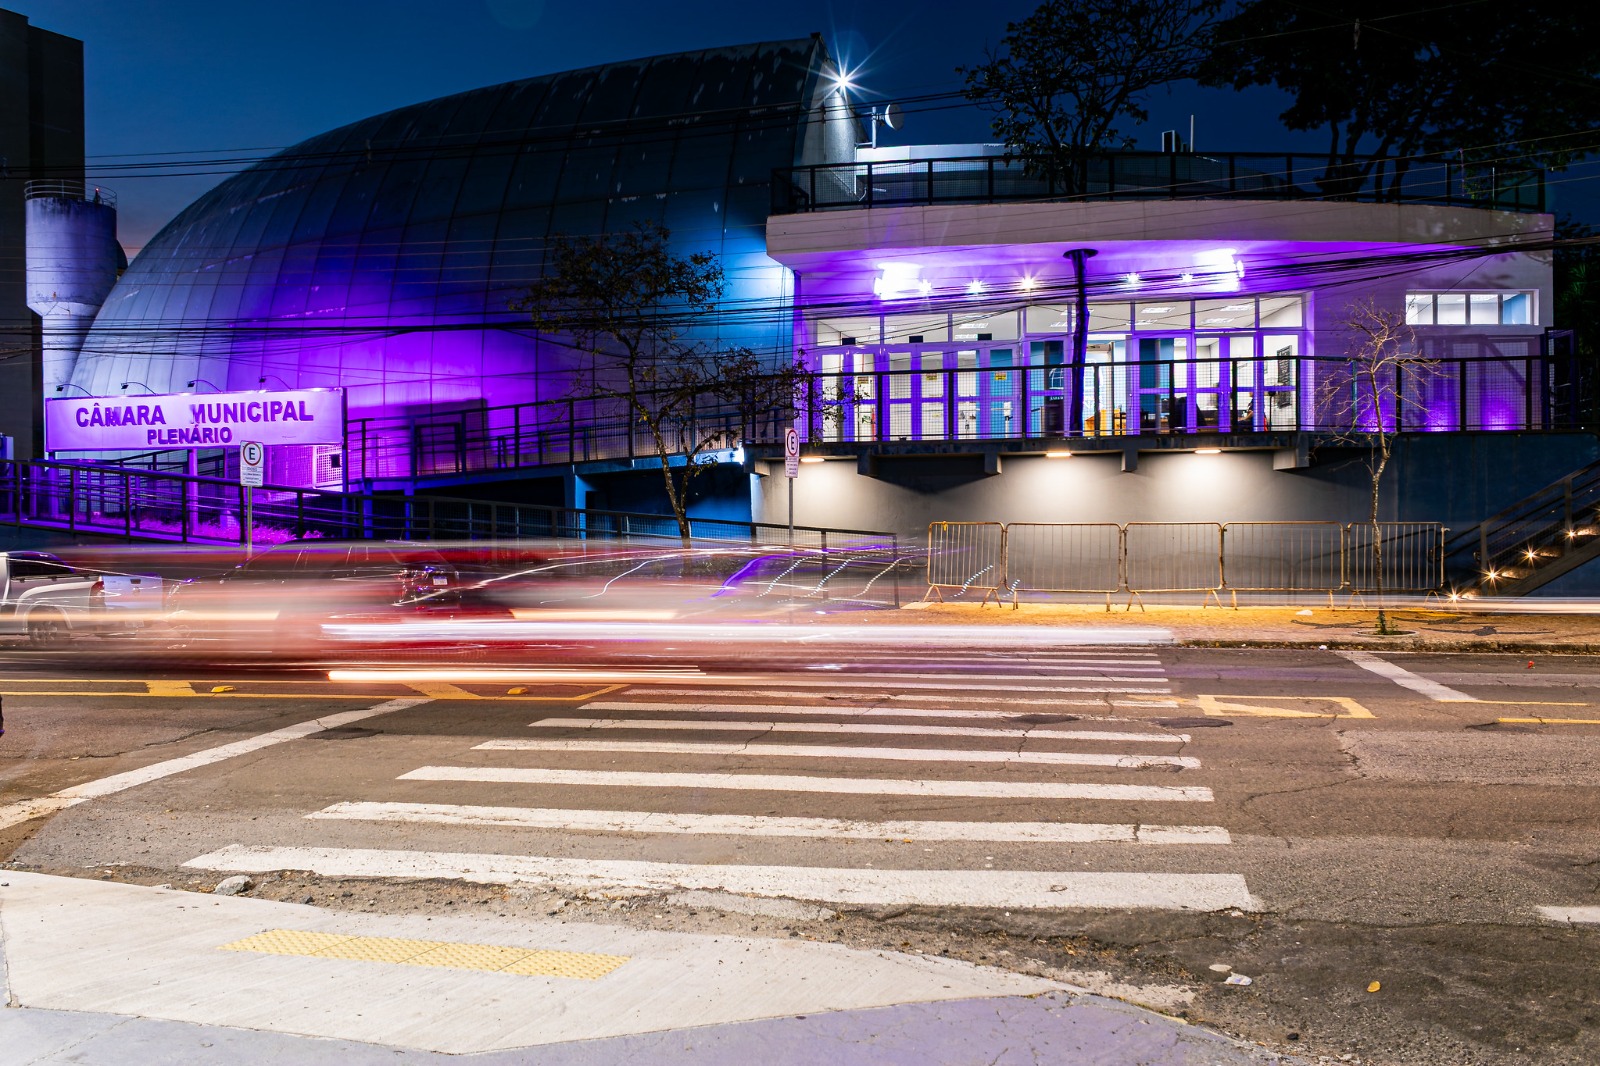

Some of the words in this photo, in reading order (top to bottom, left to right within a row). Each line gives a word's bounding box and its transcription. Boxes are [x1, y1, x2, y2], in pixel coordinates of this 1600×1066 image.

[75, 403, 167, 427] CÂMARA
[190, 401, 314, 424] MUNICIPAL
[147, 424, 233, 445] PLENÁRIO
[791, 436, 795, 450] E
[248, 447, 256, 461] E
